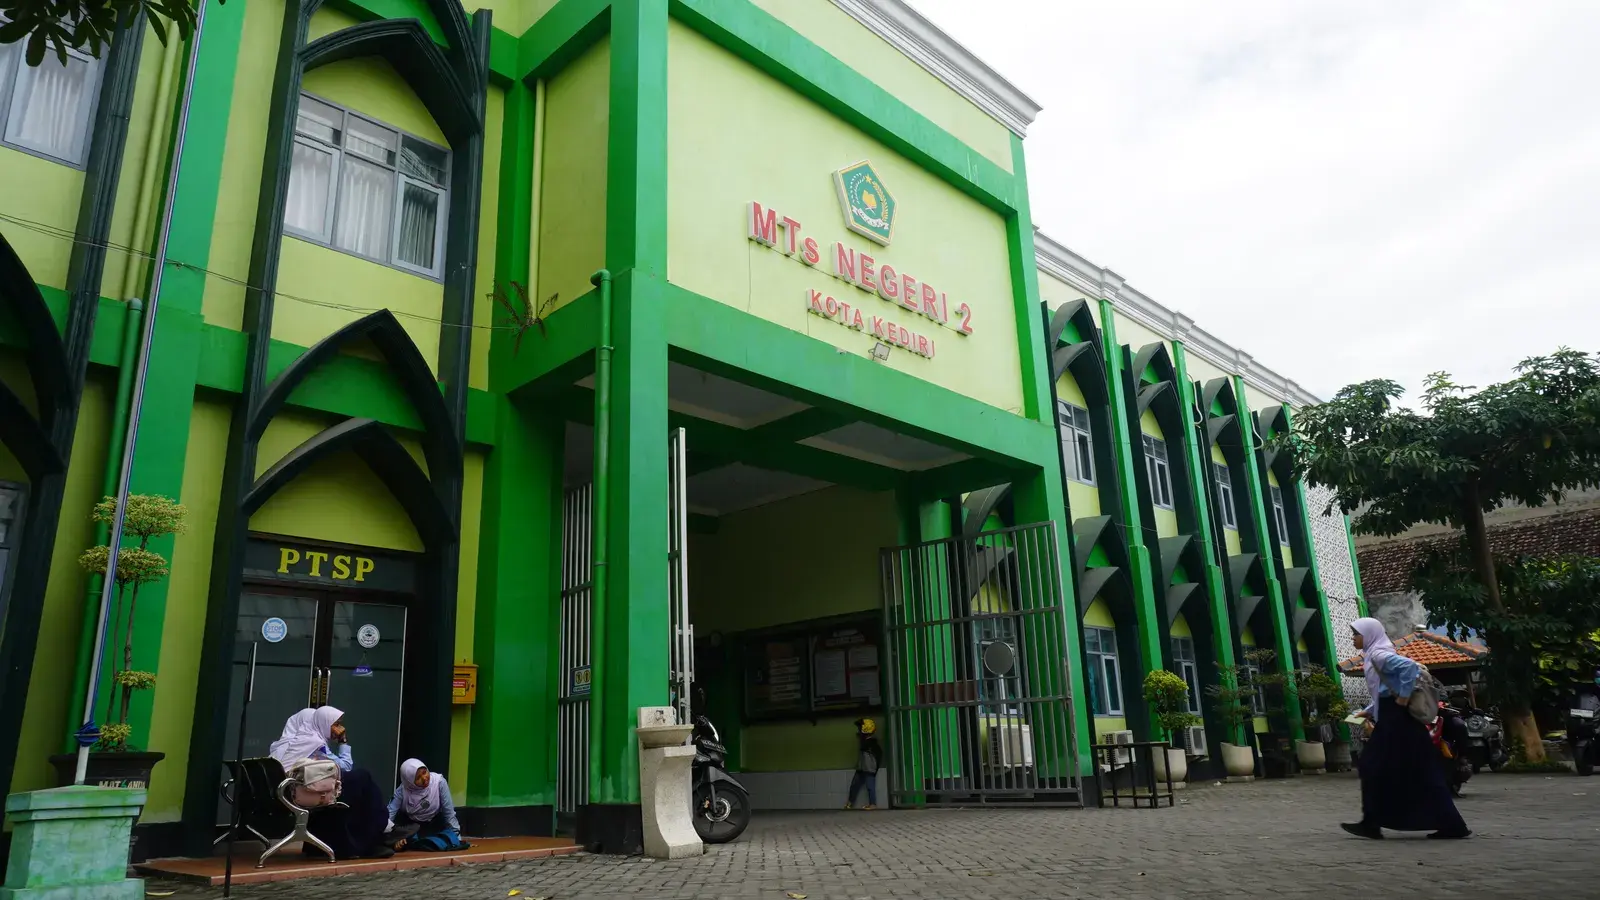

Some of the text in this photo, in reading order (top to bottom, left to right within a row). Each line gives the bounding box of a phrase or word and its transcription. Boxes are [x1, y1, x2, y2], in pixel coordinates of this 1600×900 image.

[748, 200, 974, 335] MTs NEGERI 2
[807, 288, 936, 359] KOTA KEDIRI
[277, 547, 375, 582] PTSP
